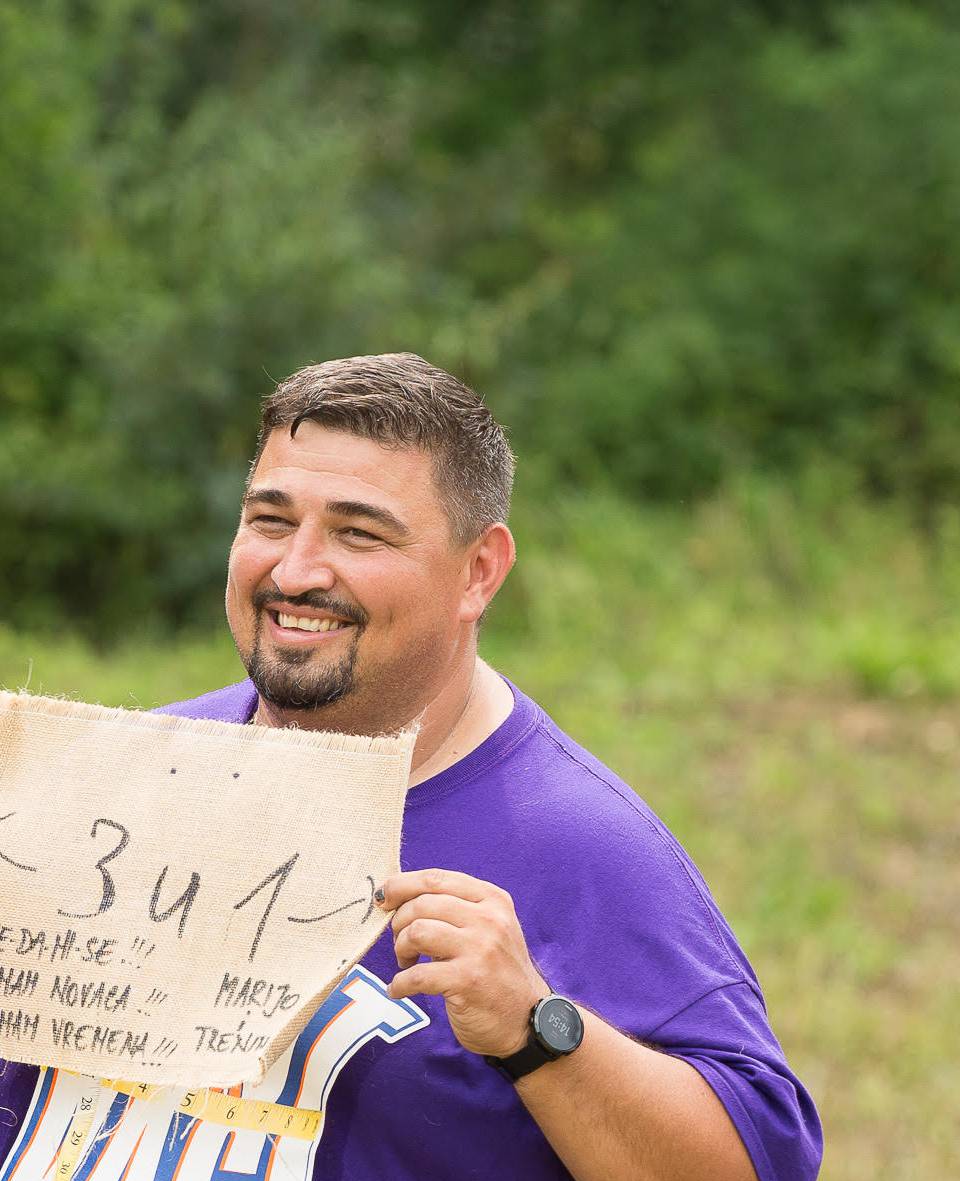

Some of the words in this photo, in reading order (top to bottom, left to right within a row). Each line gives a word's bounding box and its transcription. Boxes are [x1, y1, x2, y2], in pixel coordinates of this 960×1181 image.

[57, 818, 130, 919] 3
[80, 1096, 93, 1112] 28
[180, 1092, 195, 1108] 5
[226, 1106, 237, 1120] 6
[71, 1130, 83, 1146] 29
[60, 1160, 71, 1175] 30
